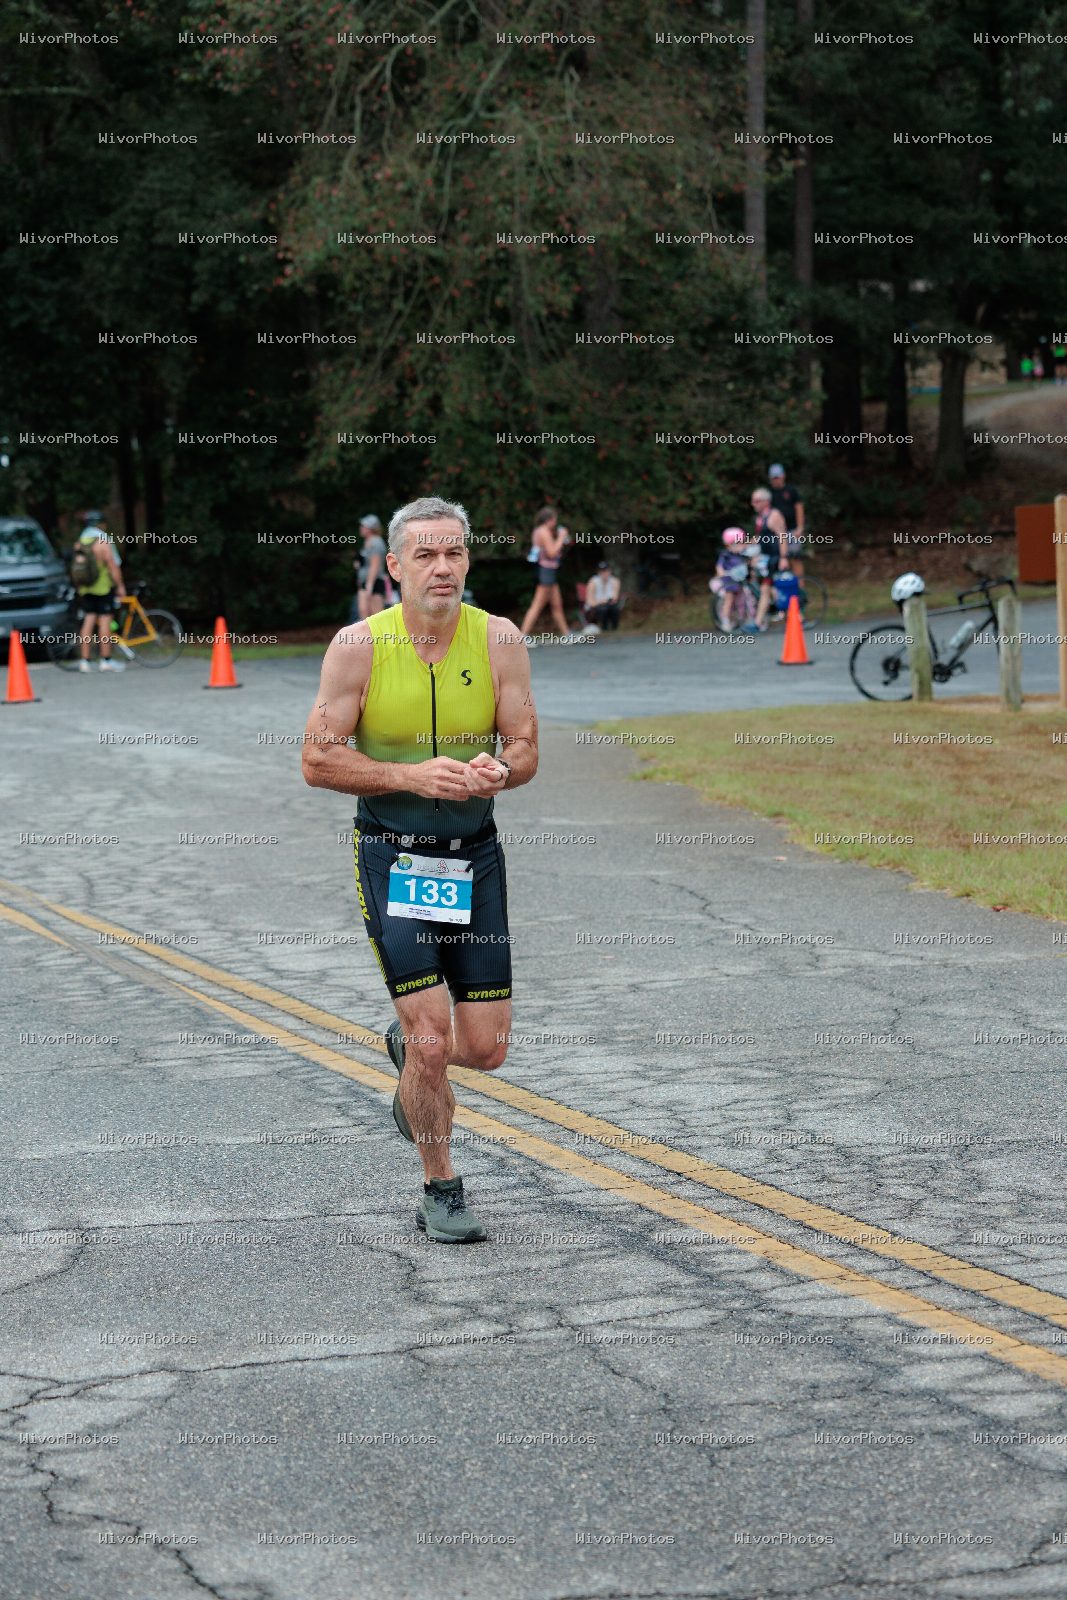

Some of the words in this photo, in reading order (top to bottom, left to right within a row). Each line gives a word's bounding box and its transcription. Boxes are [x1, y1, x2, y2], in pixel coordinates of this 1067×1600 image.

[404, 878, 459, 907] 133
[395, 973, 438, 993] synergy
[466, 987, 511, 1000] synergy
